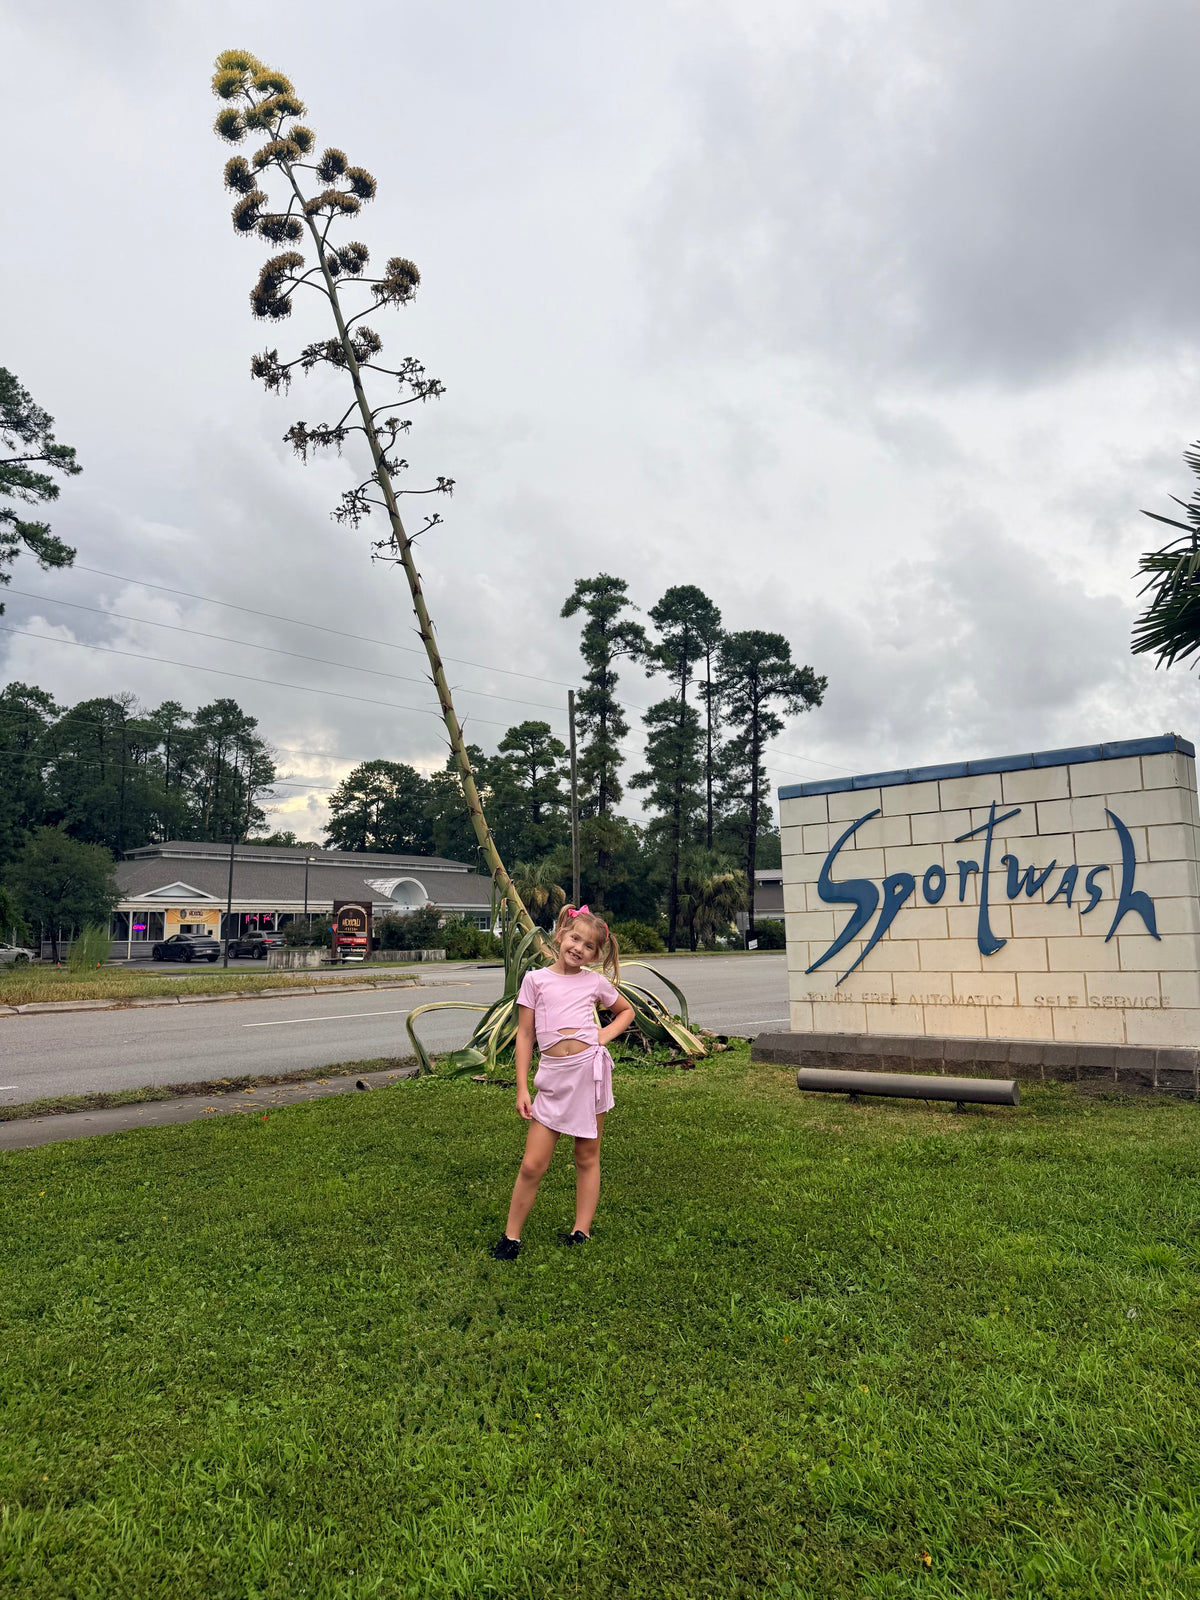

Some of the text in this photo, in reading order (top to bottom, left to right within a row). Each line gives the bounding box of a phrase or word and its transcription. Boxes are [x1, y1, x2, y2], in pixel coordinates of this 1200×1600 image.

[909, 993, 1002, 1008] AUTOMATIC
[1034, 995, 1079, 1009] SELF
[1089, 995, 1171, 1010] SERVICE
